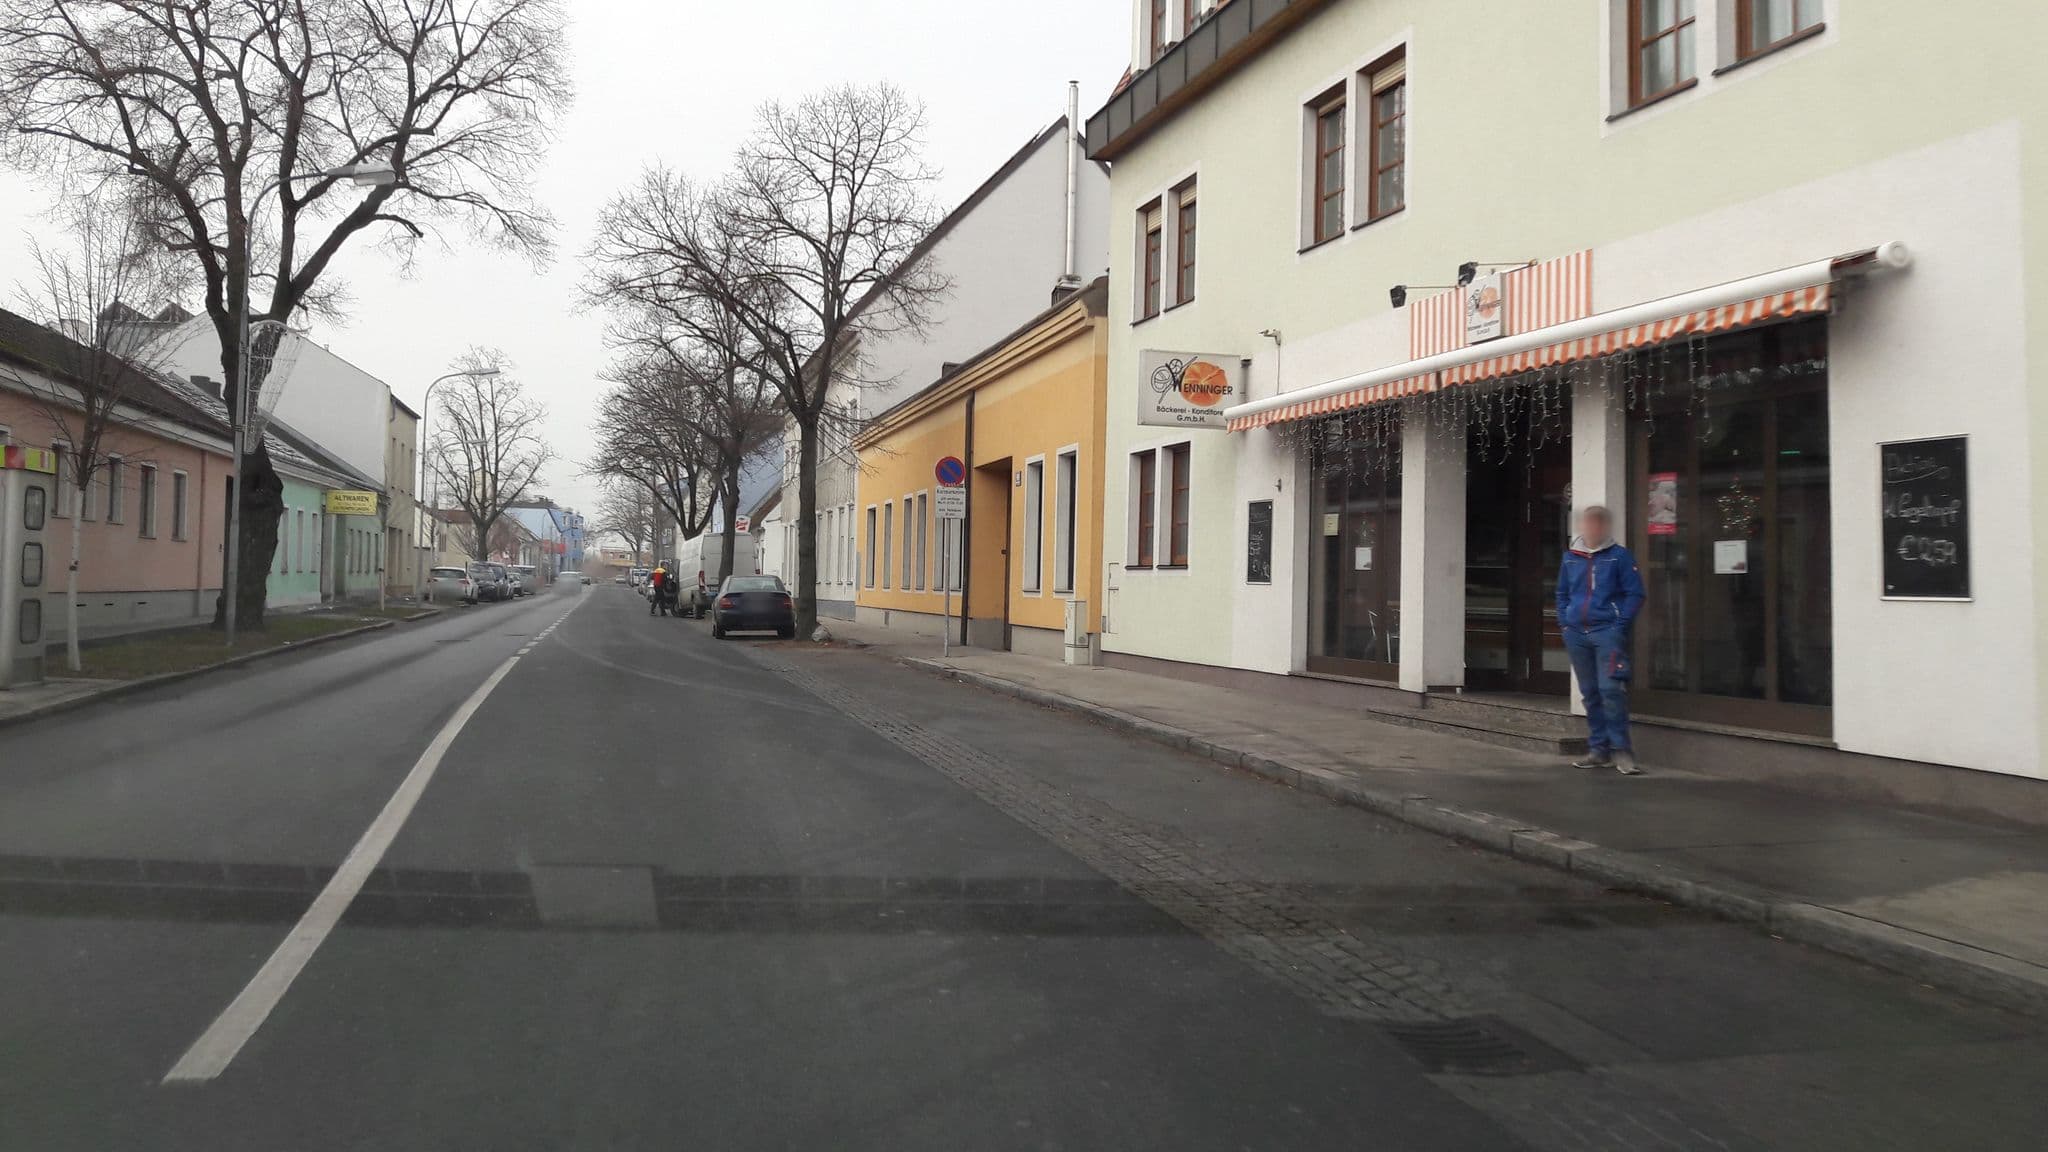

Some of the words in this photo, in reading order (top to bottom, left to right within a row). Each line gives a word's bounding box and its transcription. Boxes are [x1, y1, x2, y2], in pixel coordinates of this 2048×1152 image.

[1165, 363, 1233, 395] WENNINGER
[1156, 406, 1187, 414] Bäckerei
[1191, 408, 1224, 416] Konditore
